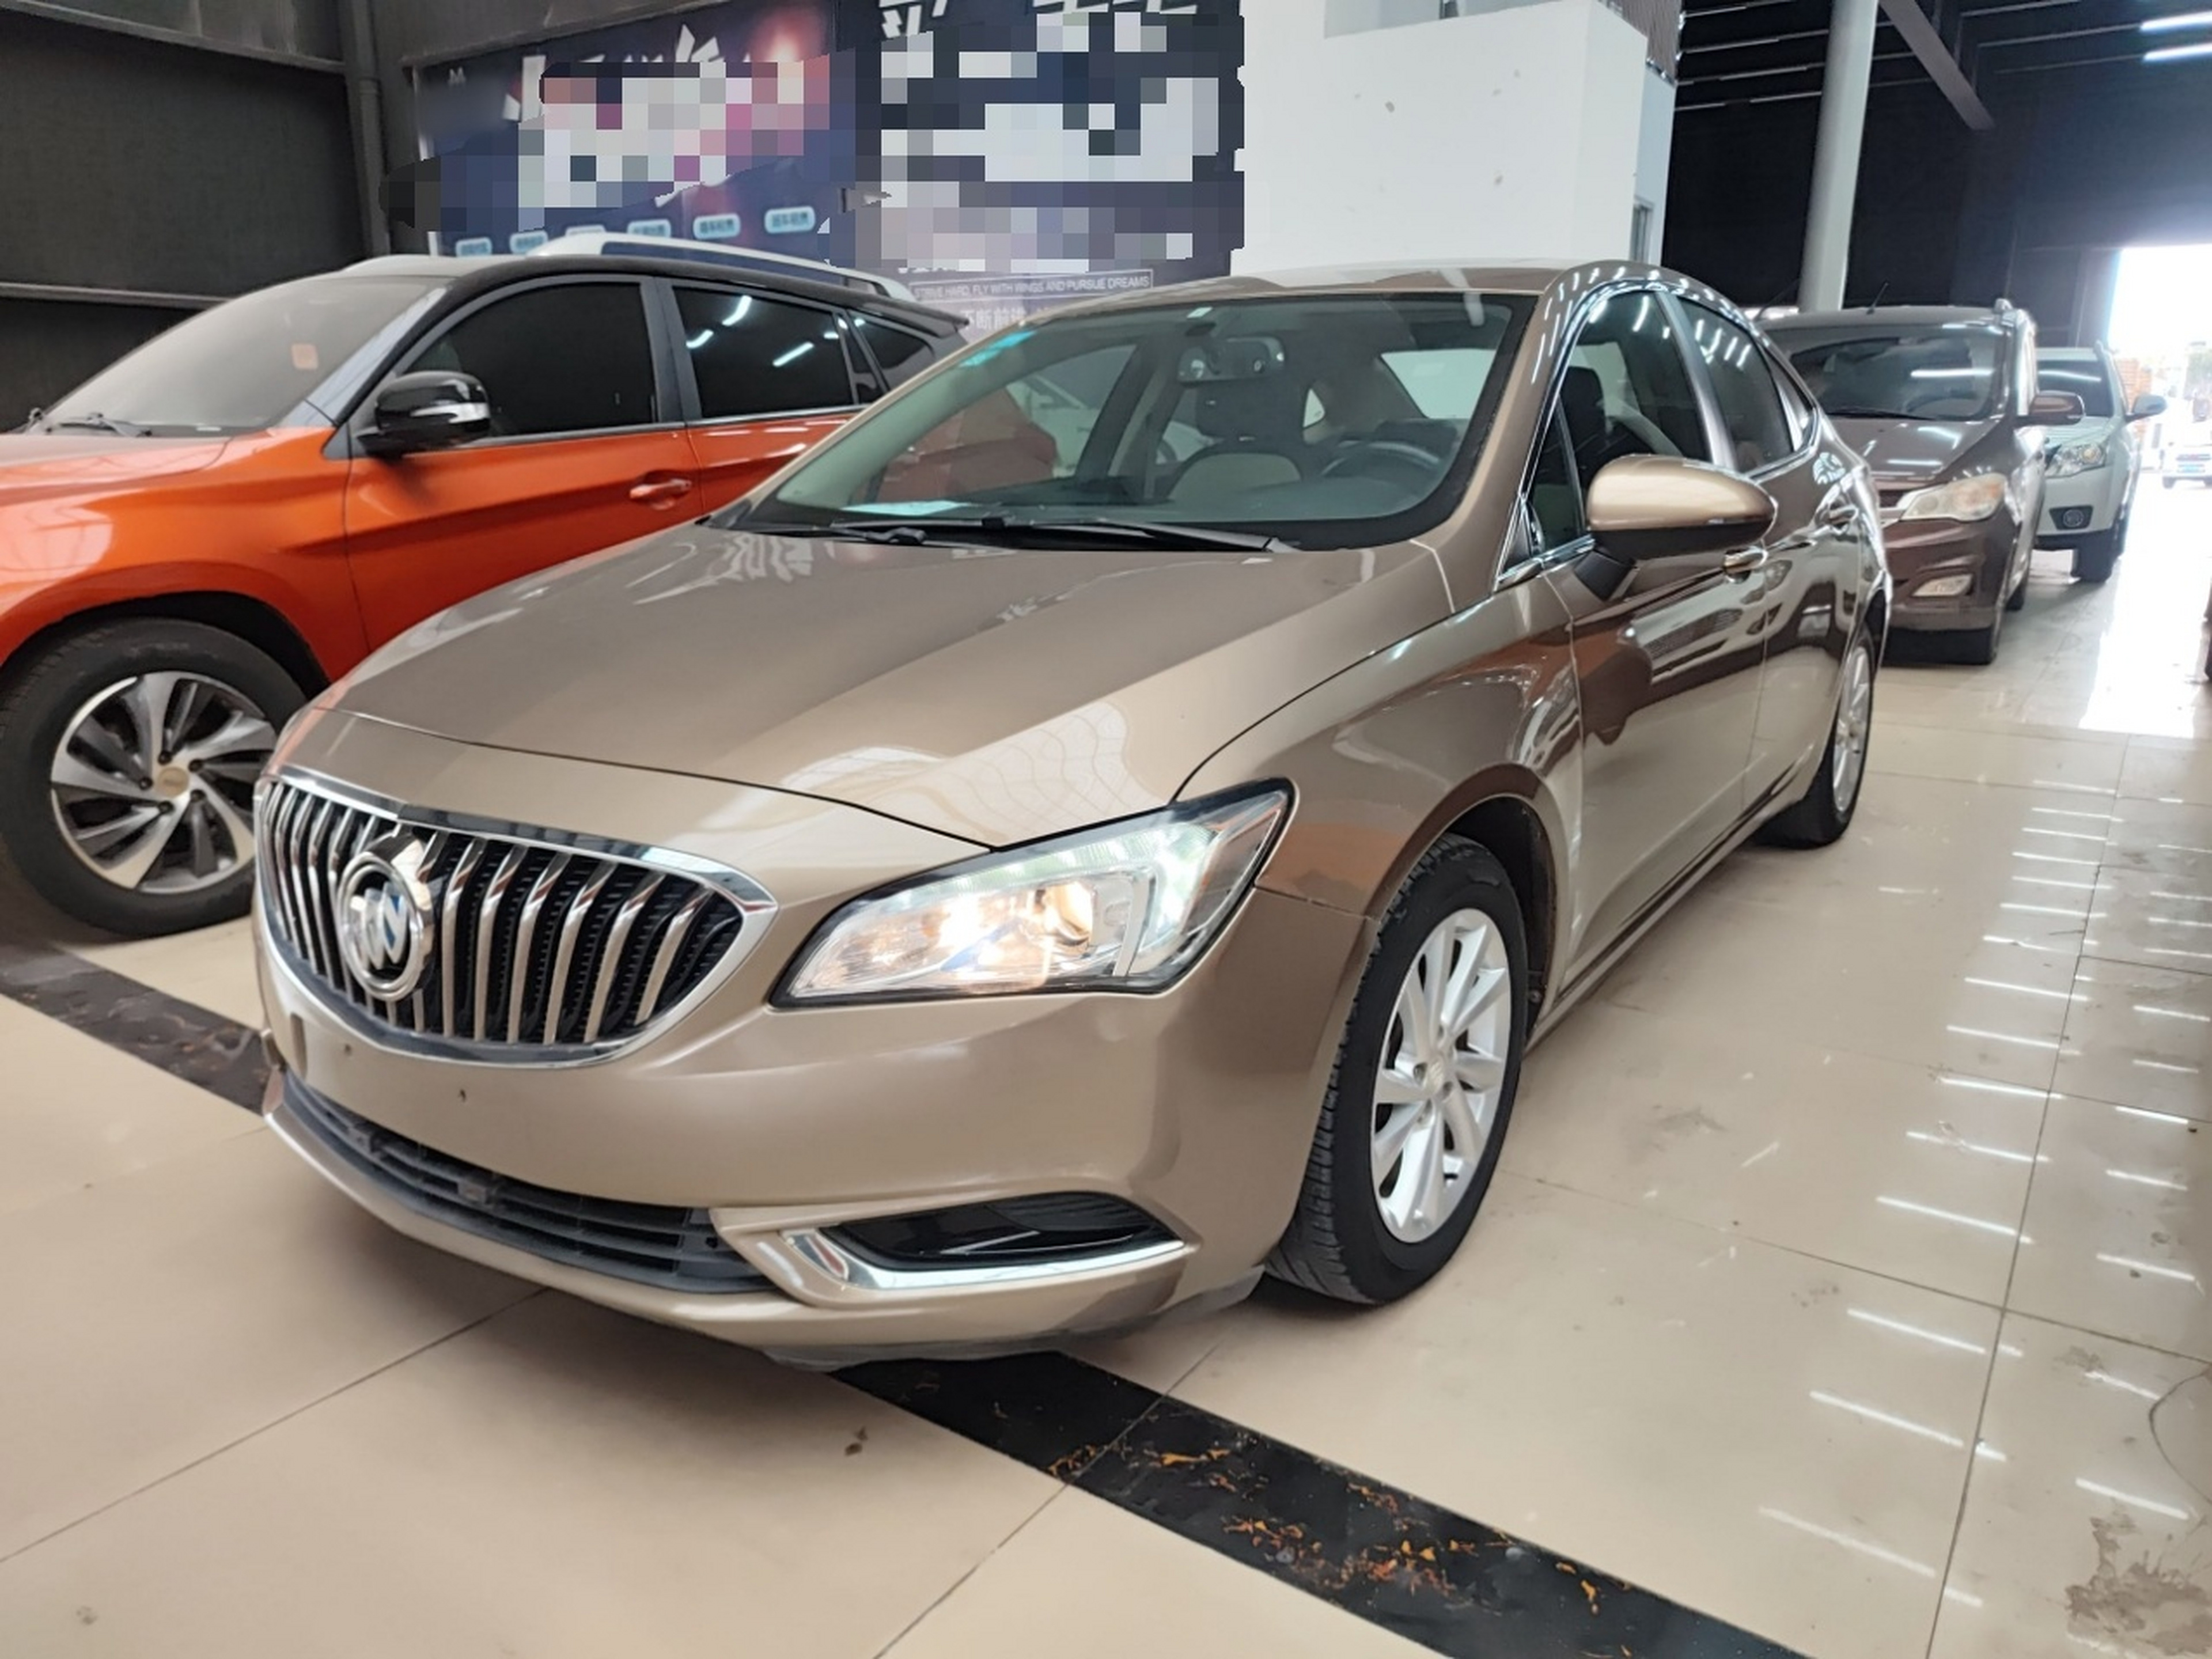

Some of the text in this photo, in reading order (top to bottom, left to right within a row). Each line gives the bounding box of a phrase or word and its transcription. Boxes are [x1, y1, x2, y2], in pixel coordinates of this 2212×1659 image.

[972, 284, 990, 296] FLY
[991, 283, 1013, 294] WITH
[1015, 281, 1043, 293] WINGS
[1046, 281, 1065, 291] AND
[1067, 278, 1106, 291] PURSUE
[1107, 276, 1150, 289] DREAMS
